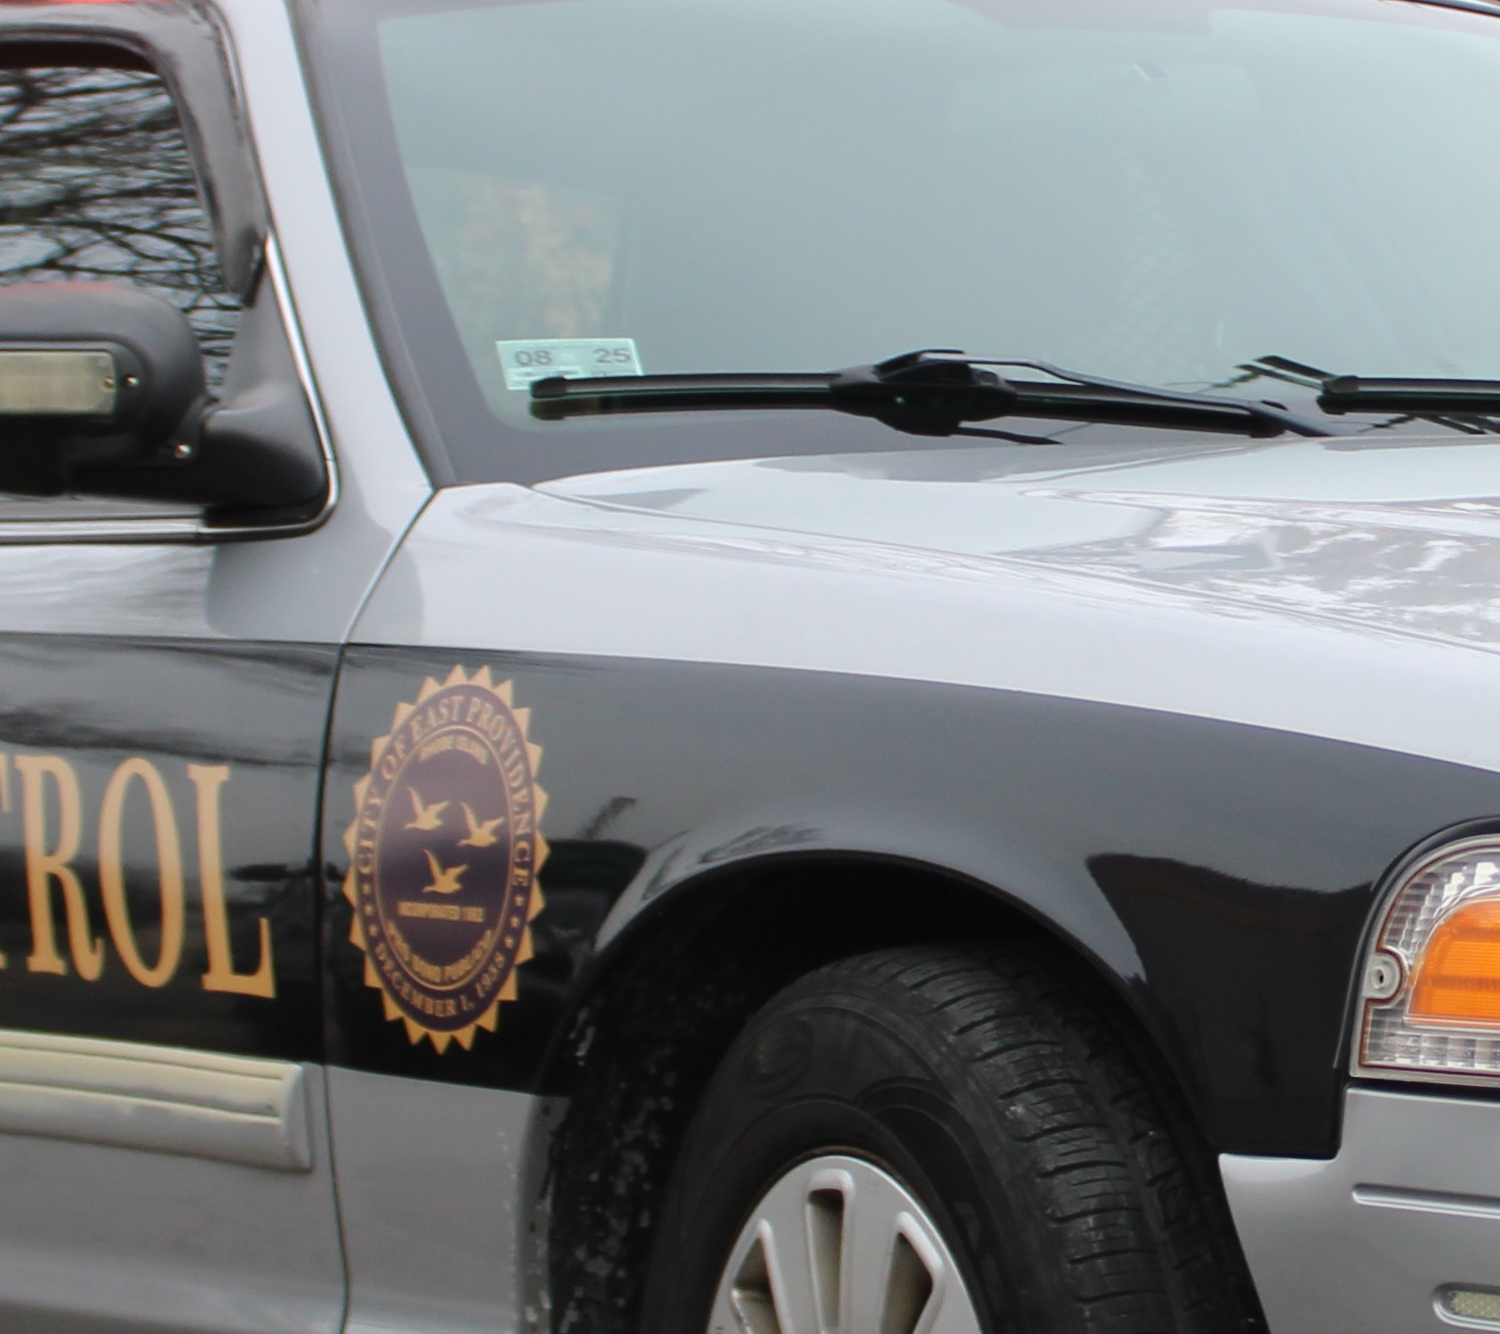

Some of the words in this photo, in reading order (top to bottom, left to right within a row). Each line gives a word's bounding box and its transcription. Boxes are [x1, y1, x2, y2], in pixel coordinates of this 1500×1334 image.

[514, 350, 553, 366] 08
[592, 348, 631, 364] 25
[356, 787, 382, 874] CITY
[381, 735, 406, 781] OF
[410, 696, 465, 742] EAST
[467, 696, 532, 886] PROVIDENCE
